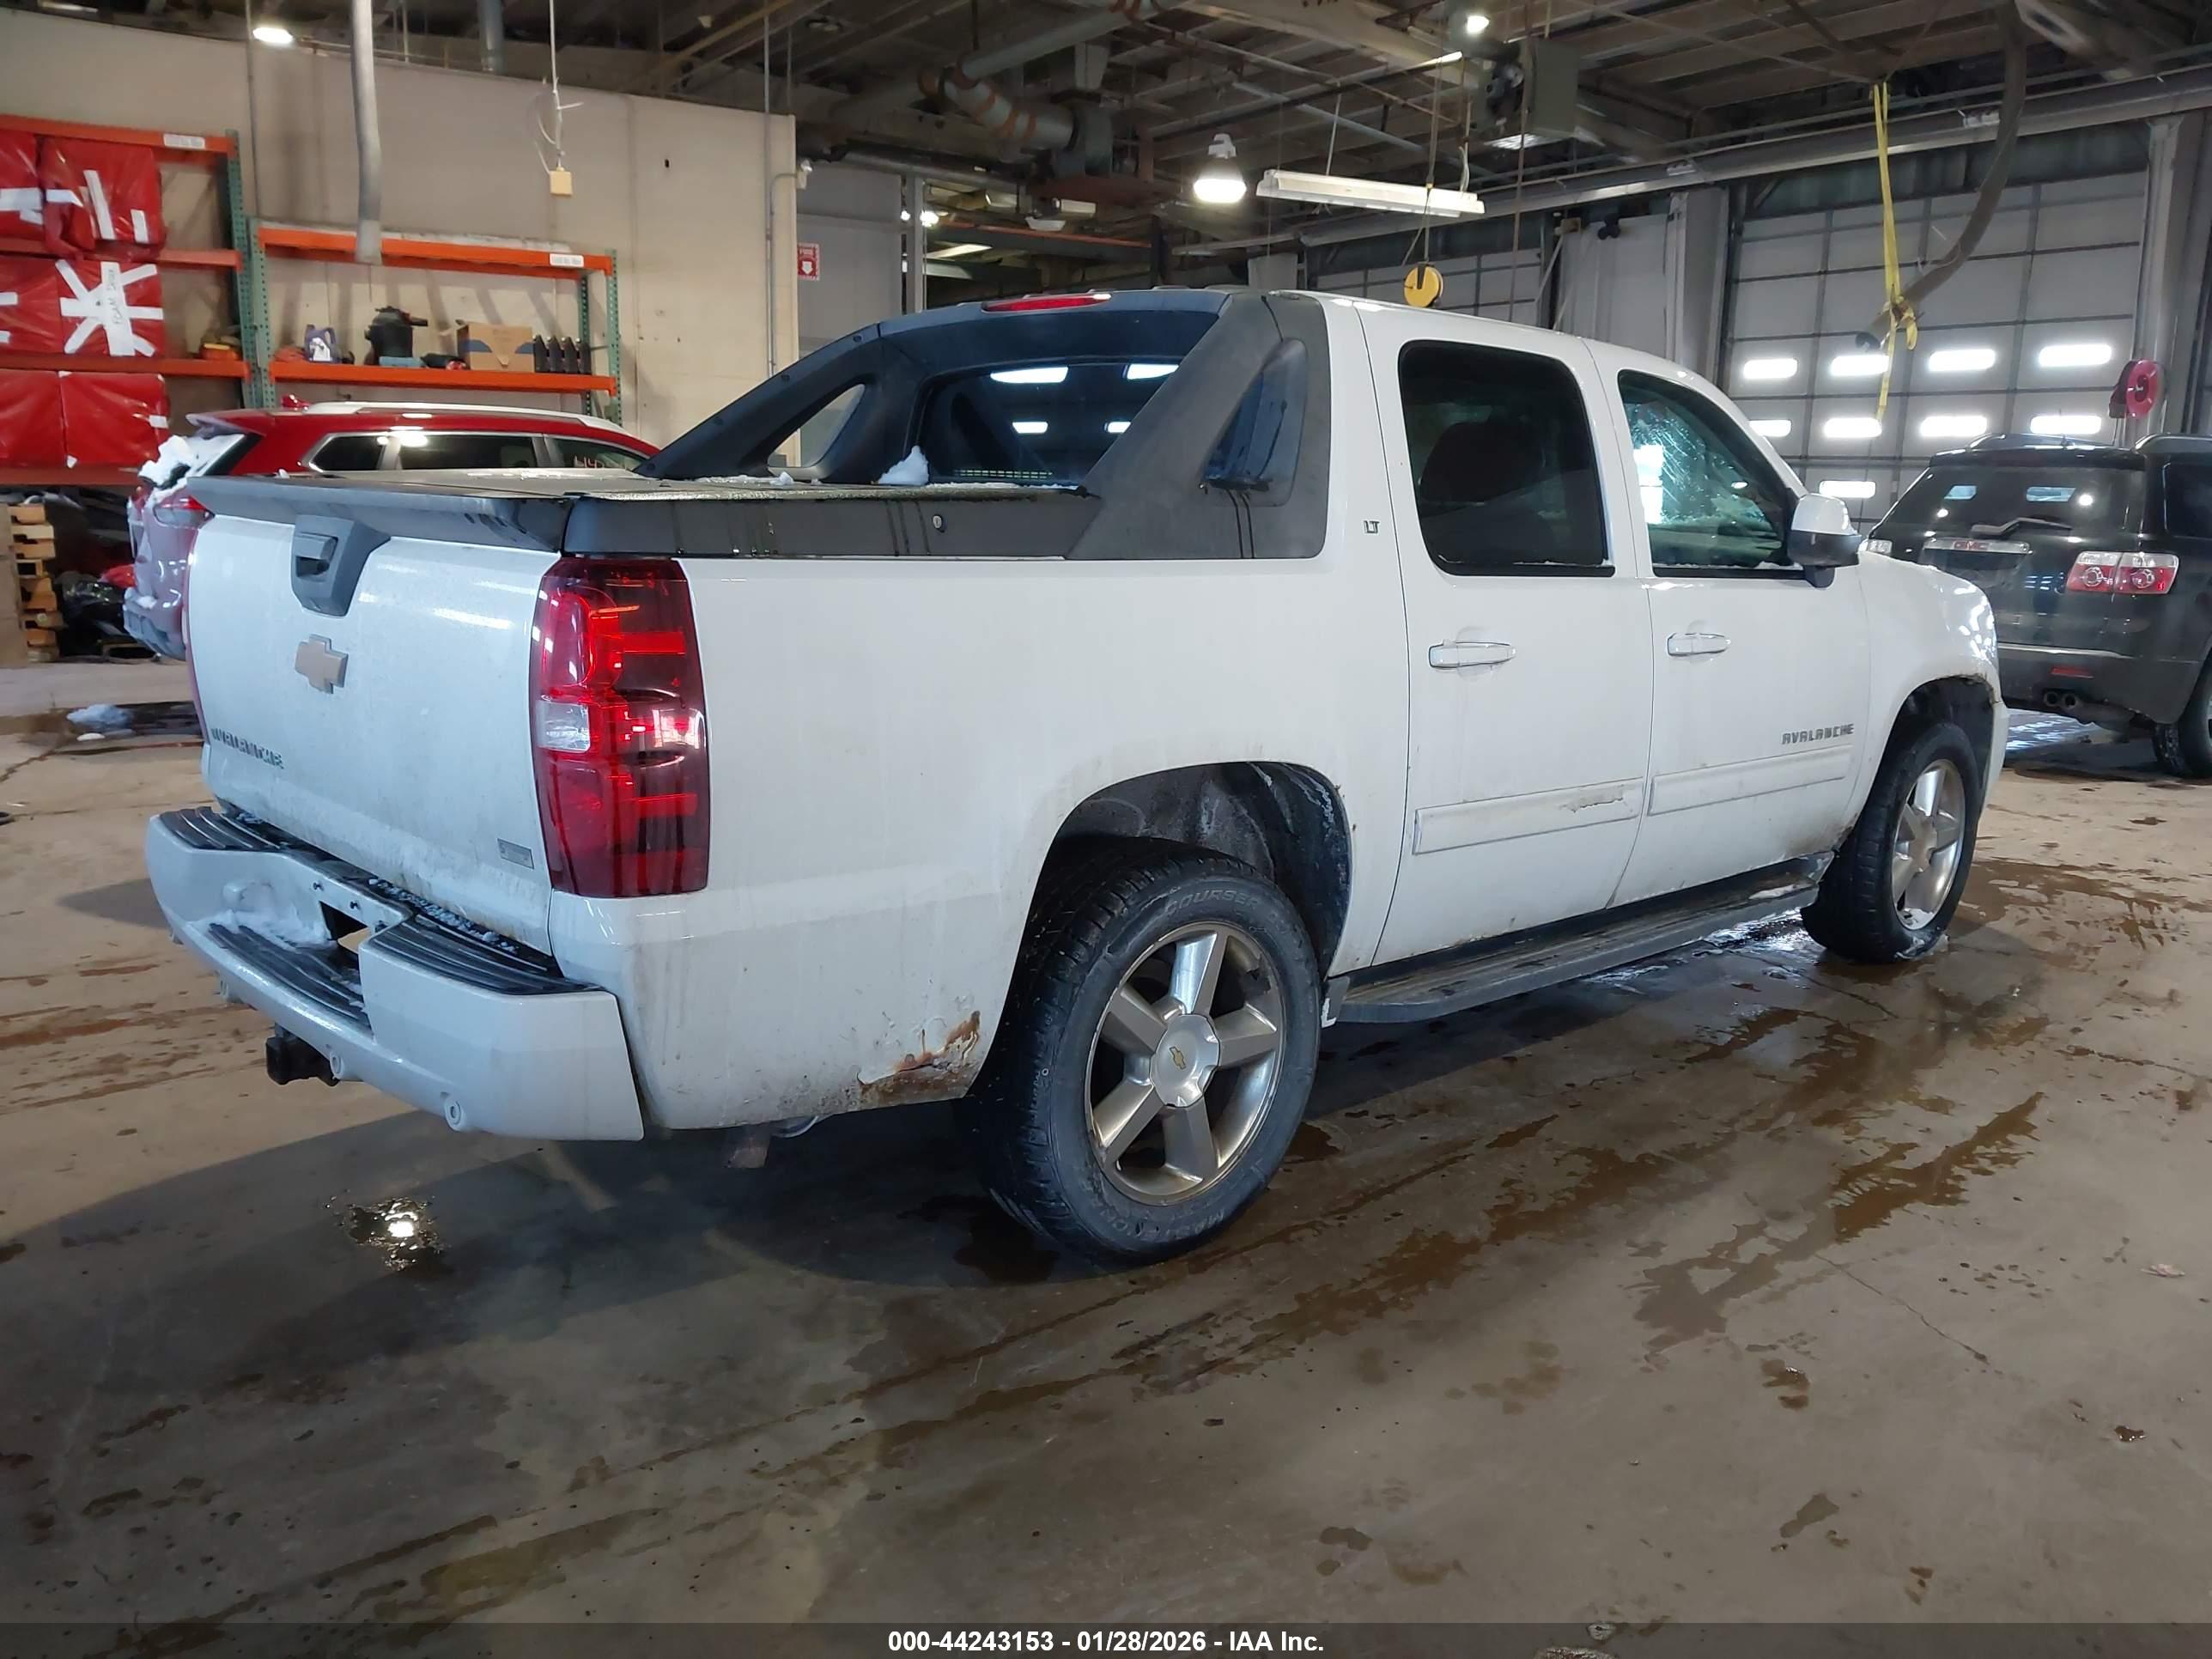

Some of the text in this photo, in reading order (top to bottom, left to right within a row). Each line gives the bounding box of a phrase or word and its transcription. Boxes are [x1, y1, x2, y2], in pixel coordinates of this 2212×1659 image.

[1364, 520, 1379, 533] LT
[1954, 540, 1990, 550] GMC
[1782, 723, 1854, 744] AVALANCHE
